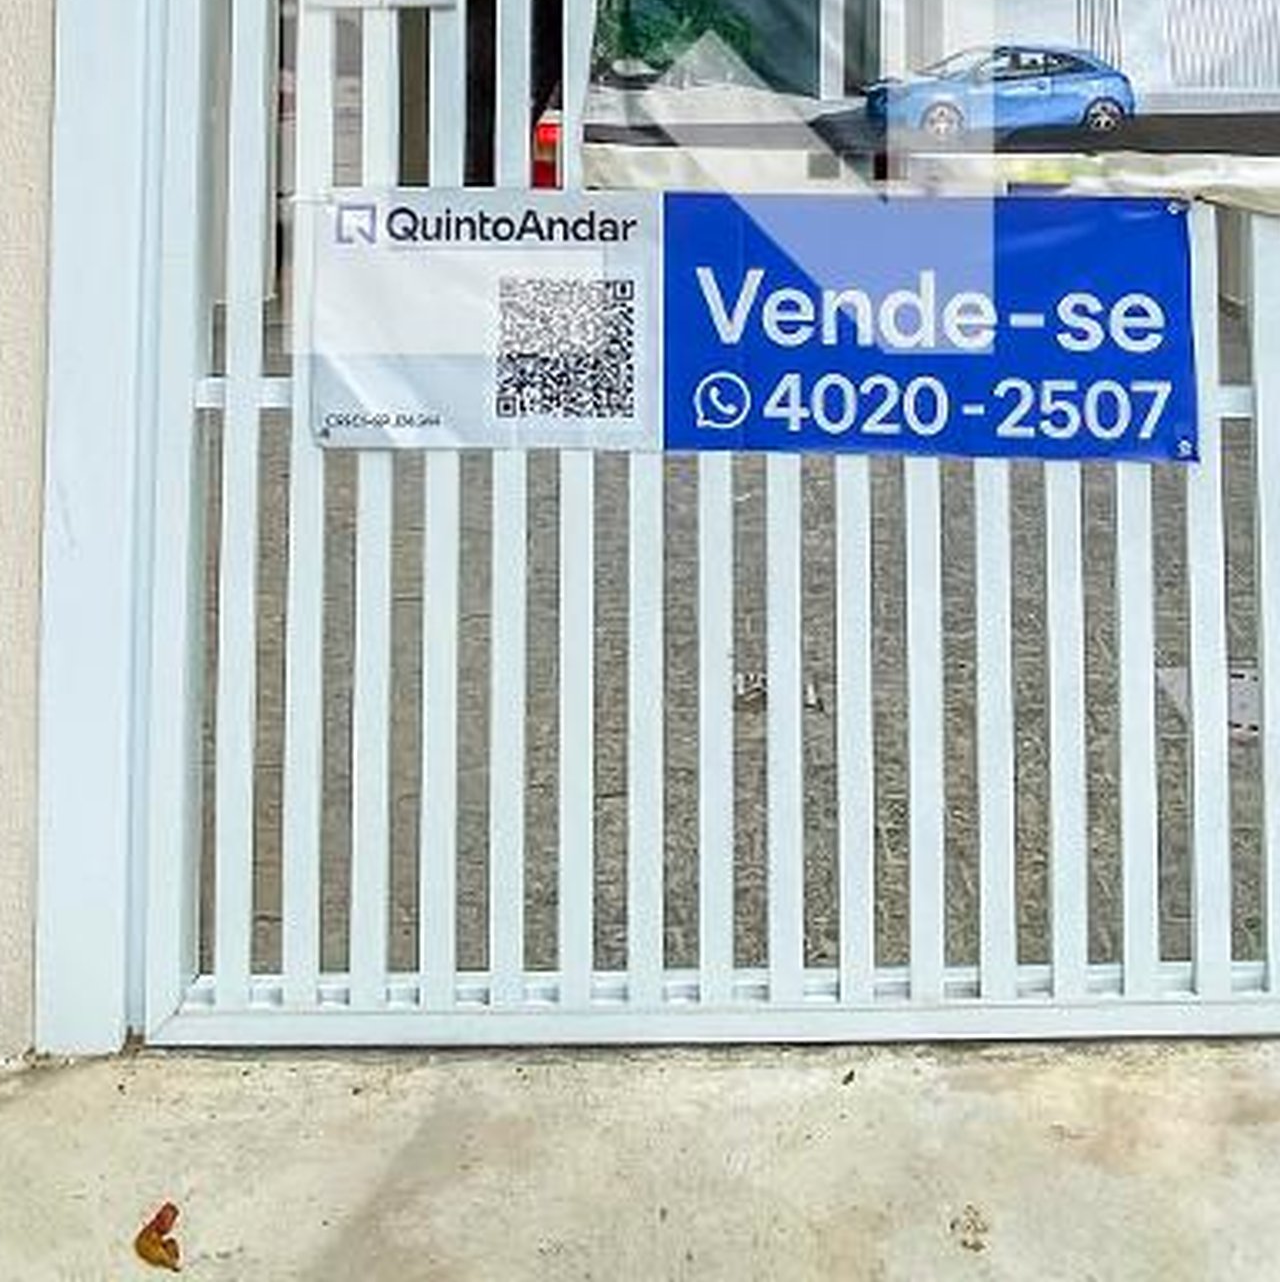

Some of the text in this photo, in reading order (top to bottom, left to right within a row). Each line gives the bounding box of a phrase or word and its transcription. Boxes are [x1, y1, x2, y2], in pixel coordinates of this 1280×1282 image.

[386, 207, 637, 242] QuintoAndar
[695, 265, 1166, 354] Vende-se
[762, 373, 1174, 440] 4020-2507
